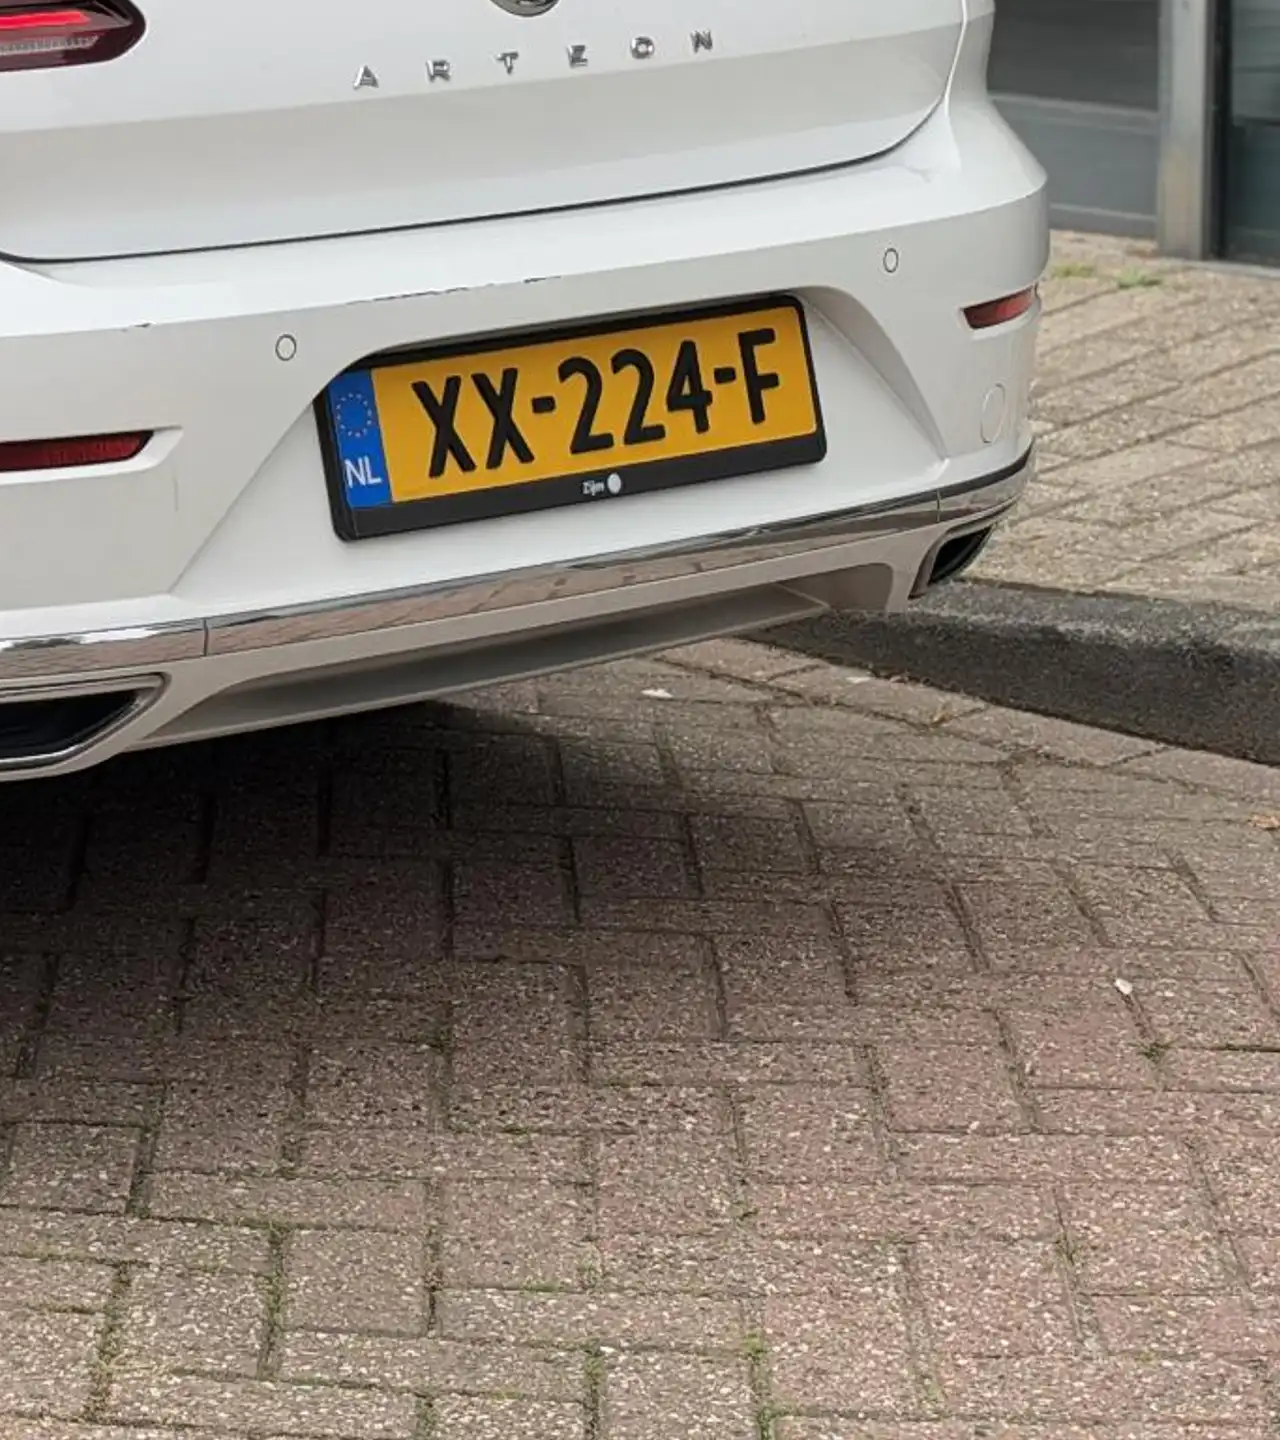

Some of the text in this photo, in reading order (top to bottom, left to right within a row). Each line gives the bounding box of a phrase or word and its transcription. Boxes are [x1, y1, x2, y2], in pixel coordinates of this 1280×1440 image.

[352, 29, 714, 90] ARTEON
[411, 328, 779, 479] XX-224-F
[344, 455, 382, 489] NL
